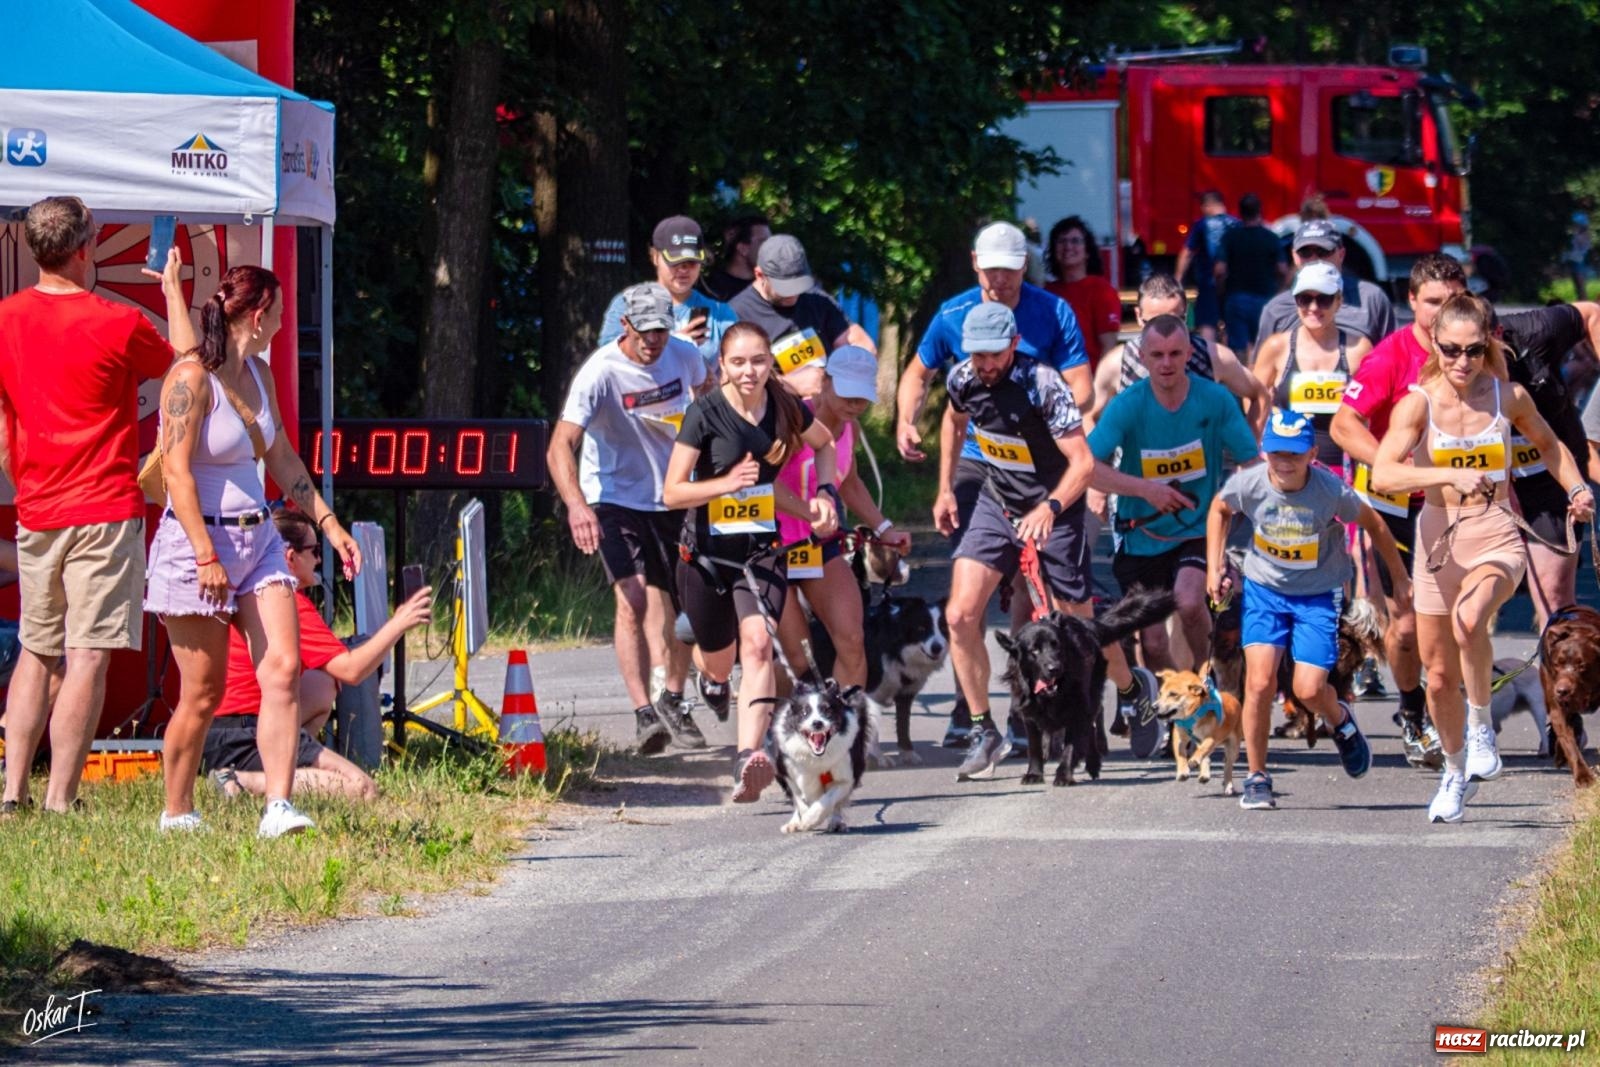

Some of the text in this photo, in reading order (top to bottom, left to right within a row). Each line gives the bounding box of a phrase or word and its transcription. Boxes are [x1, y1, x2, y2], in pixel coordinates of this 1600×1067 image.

[171, 152, 228, 170] MITKO
[987, 444, 1019, 460] 013
[1517, 448, 1541, 464] 00
[1157, 458, 1193, 475] 001
[1451, 454, 1489, 468] 021
[723, 503, 760, 519] 026
[789, 550, 809, 565] 29
[1267, 546, 1303, 560] 031
